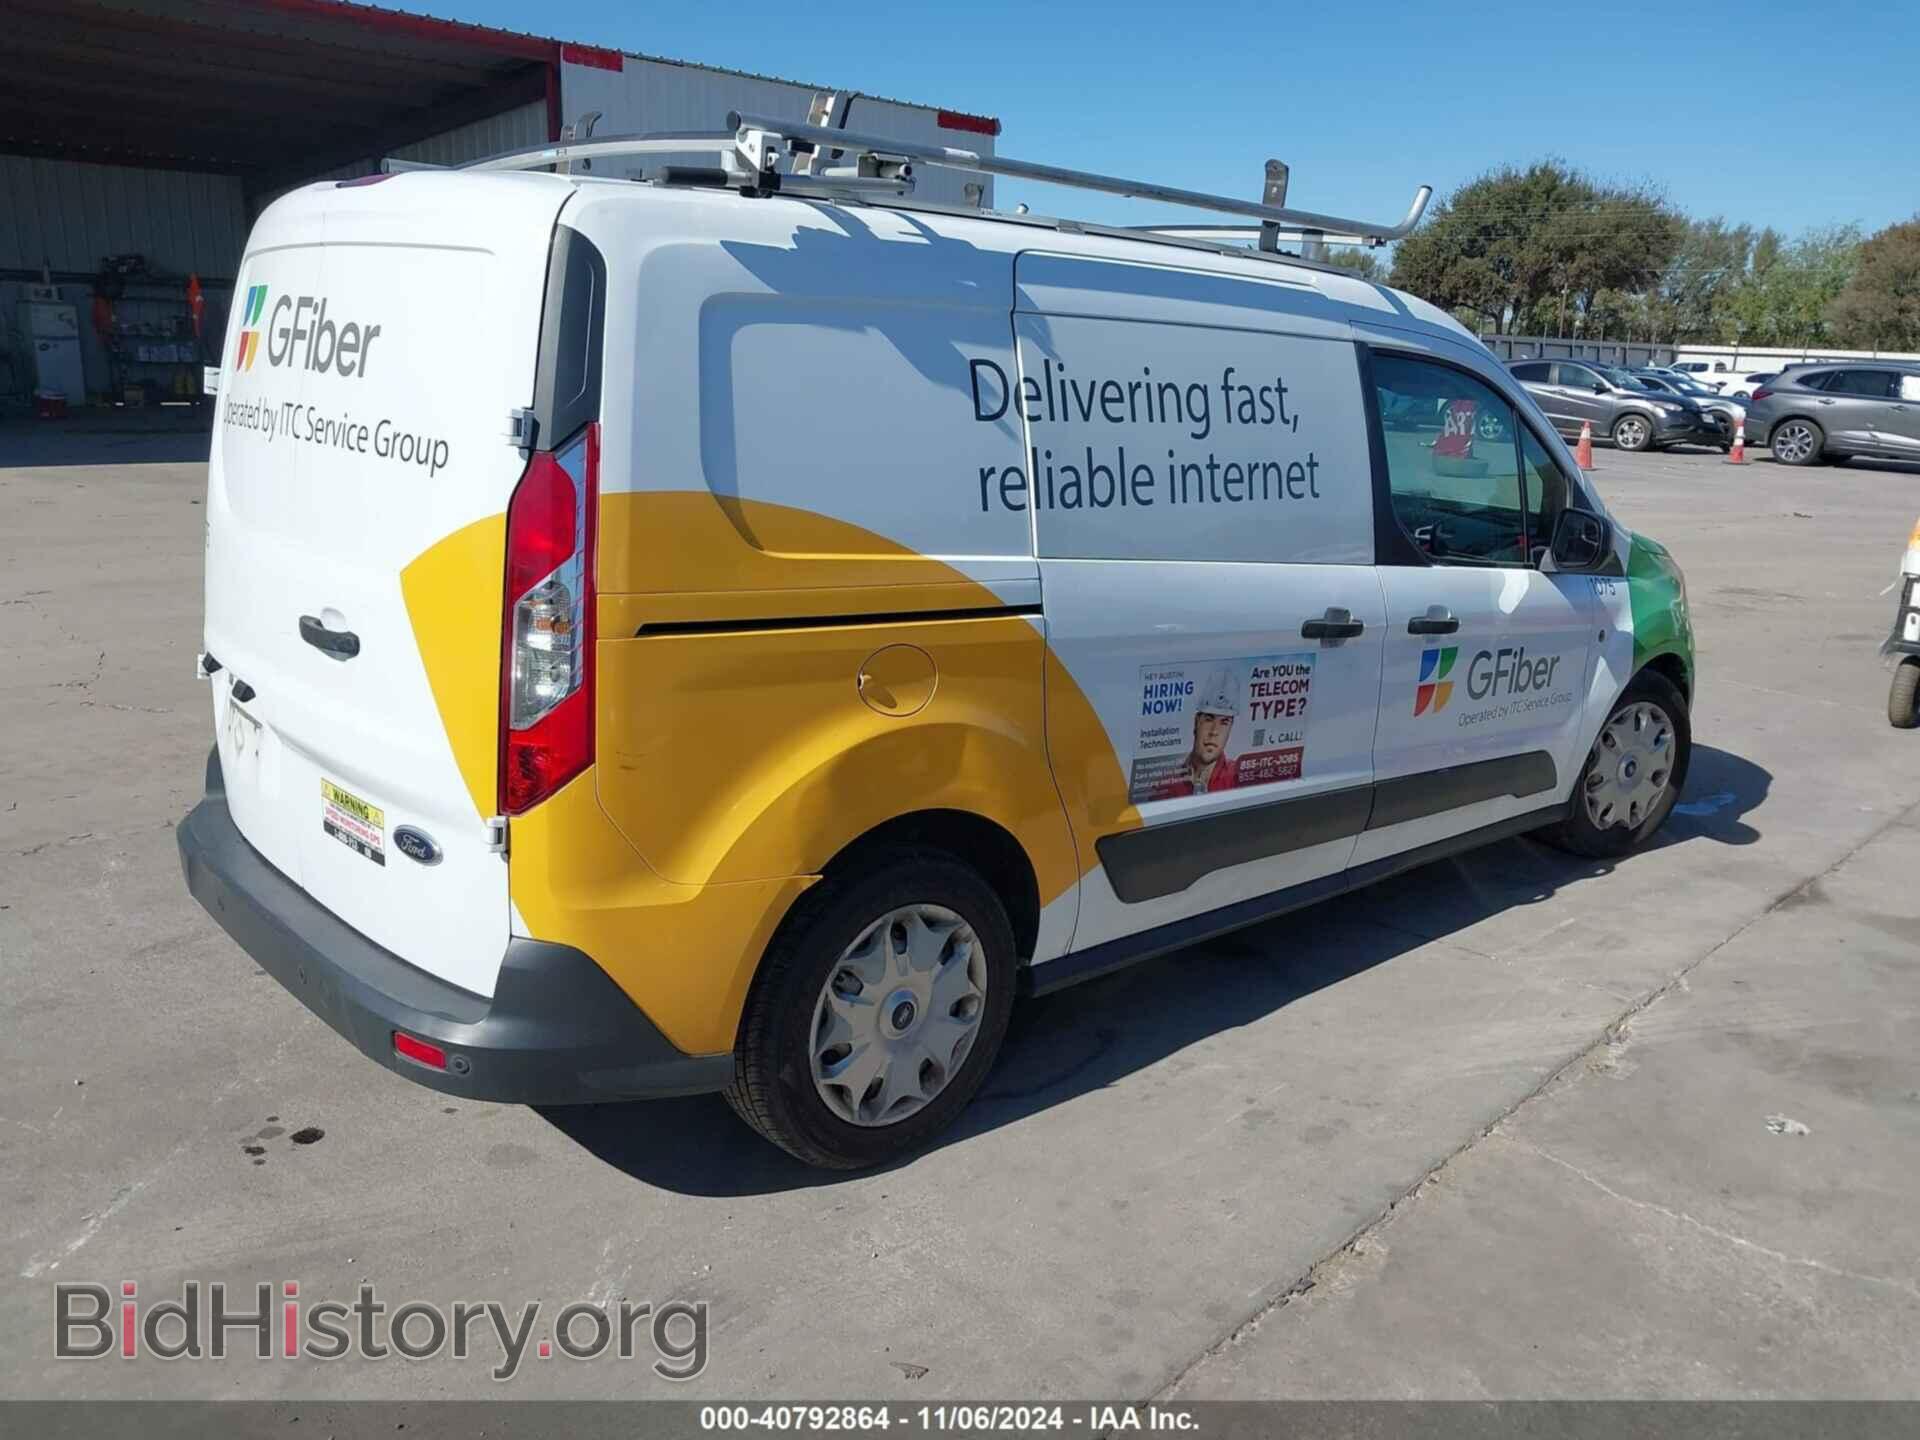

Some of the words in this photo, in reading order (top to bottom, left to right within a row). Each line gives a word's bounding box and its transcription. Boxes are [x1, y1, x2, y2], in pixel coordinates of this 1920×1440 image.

[268, 294, 381, 378] GFiber
[969, 358, 1211, 439] Delivering
[1220, 367, 1299, 432] fast,
[261, 397, 278, 442] by
[280, 402, 303, 439] ITC
[304, 406, 369, 453] Service
[374, 419, 449, 477] Group
[979, 446, 1155, 512] reliable
[1167, 449, 1320, 504] internet
[1251, 666, 1270, 679] Are
[1272, 665, 1294, 677] YOU
[1296, 664, 1311, 676] the
[1467, 647, 1560, 700] GFiber
[1143, 681, 1194, 699] HIRING
[1250, 679, 1310, 697] TELECOM
[1142, 699, 1183, 716] NOW!
[1250, 698, 1307, 721] TYPE?
[1458, 708, 1497, 727] Operated
[1139, 727, 1180, 738] Installation
[1139, 738, 1182, 750] Technicians
